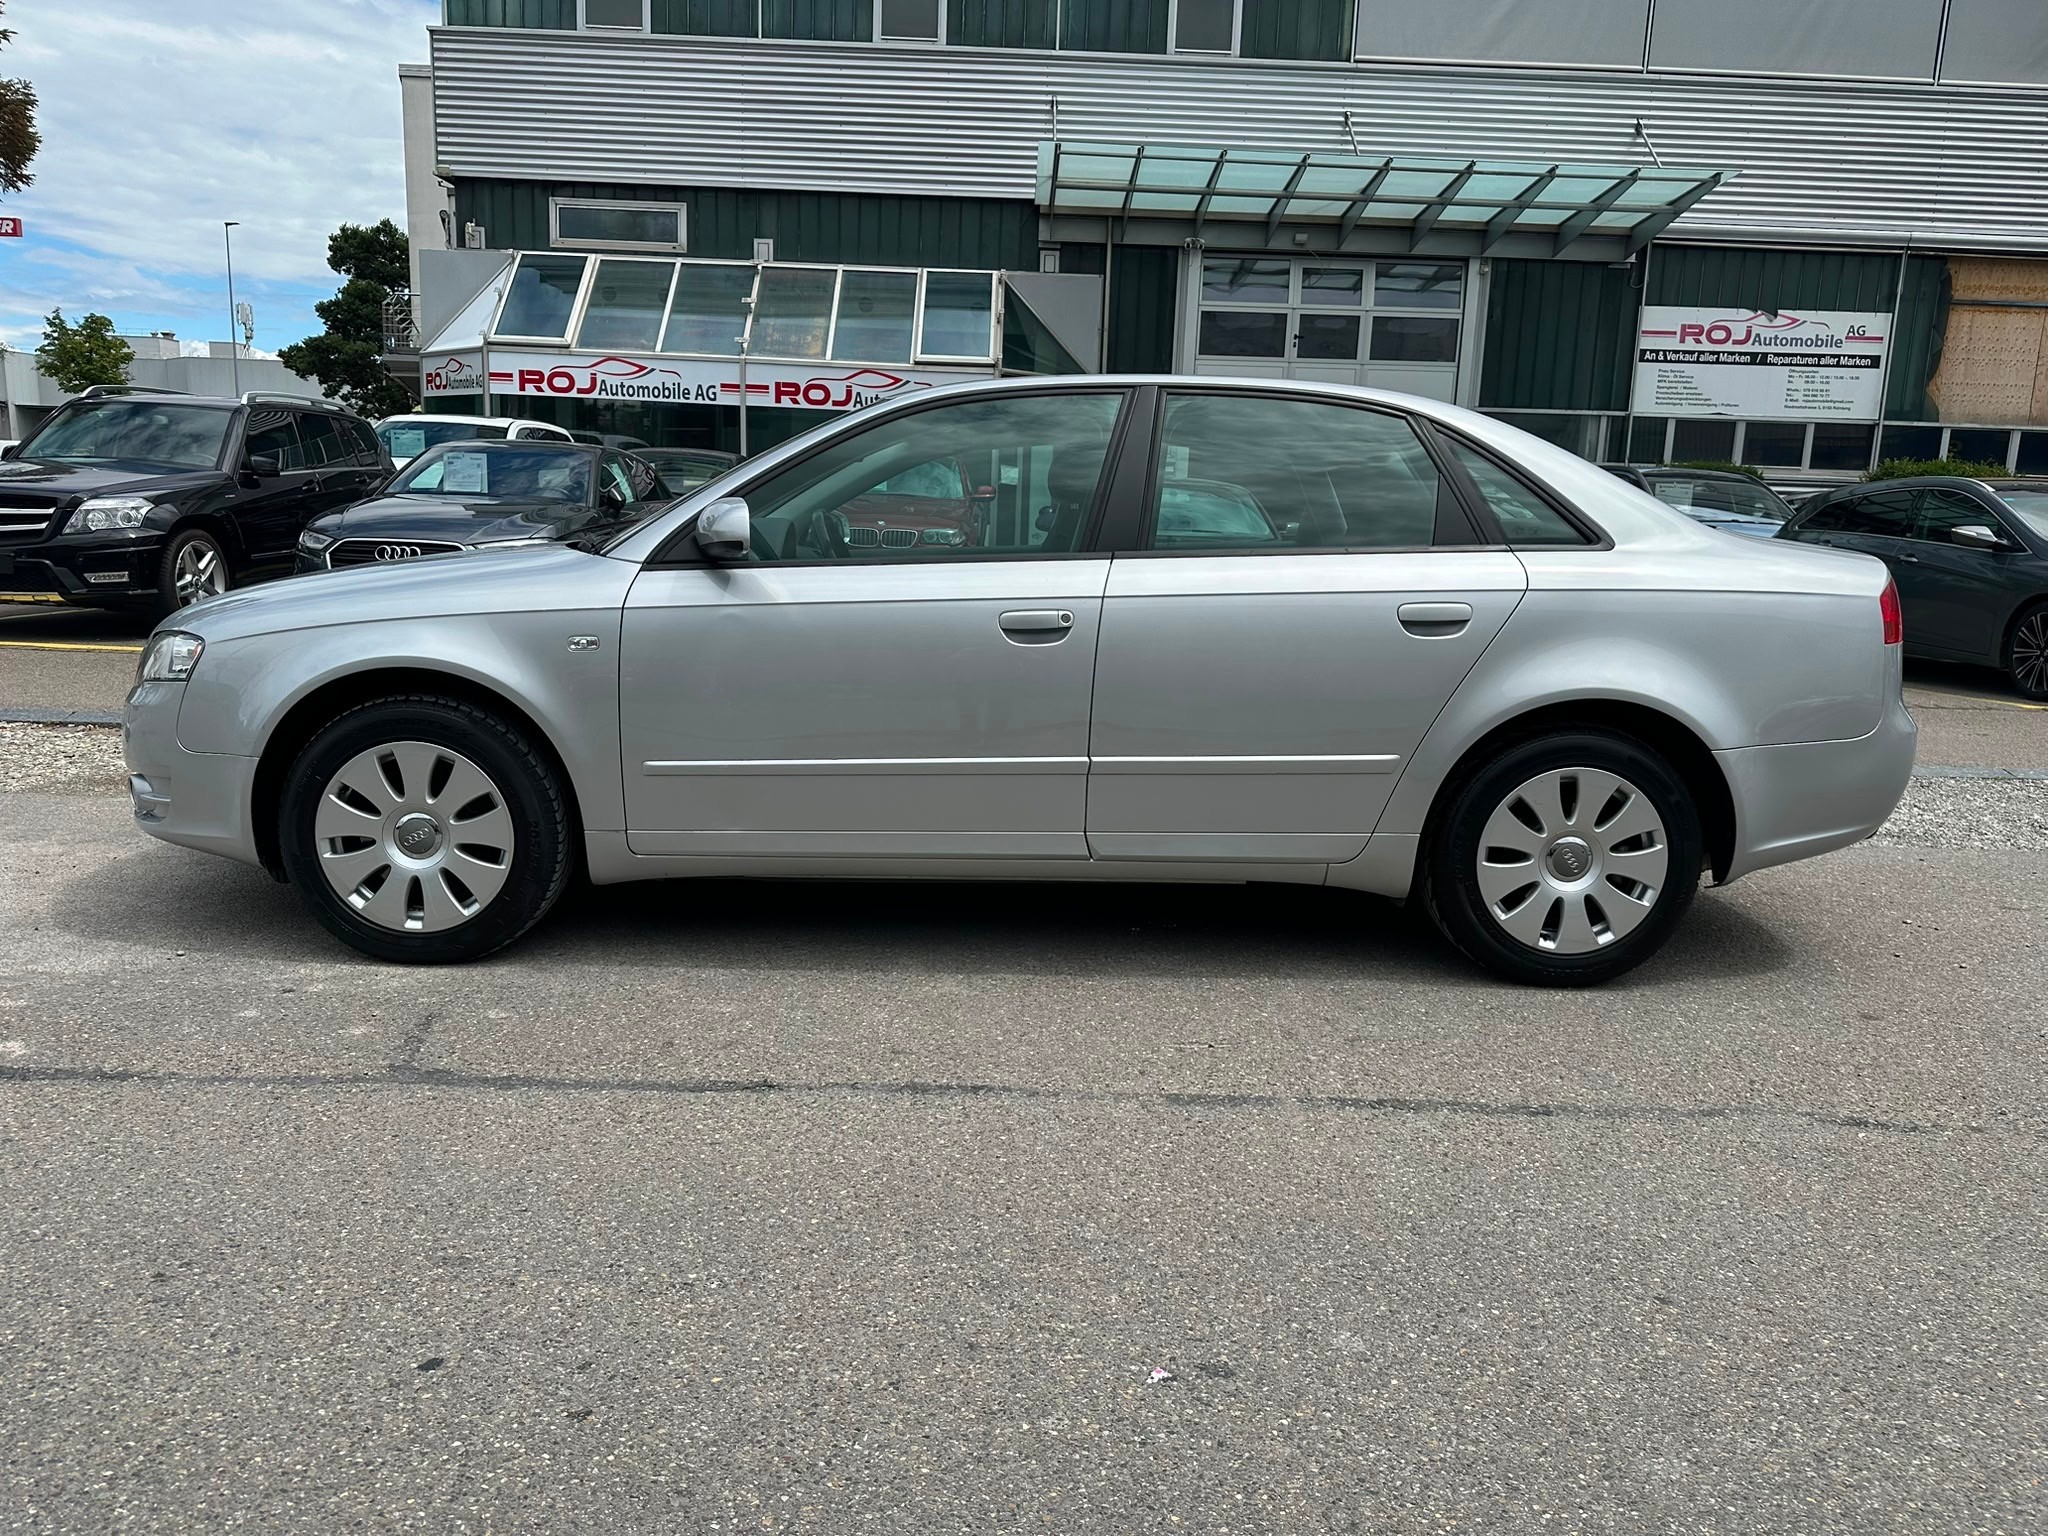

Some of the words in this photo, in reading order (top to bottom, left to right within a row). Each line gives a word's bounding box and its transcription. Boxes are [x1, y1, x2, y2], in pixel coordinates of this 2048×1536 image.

[0, 219, 14, 233] R
[1679, 323, 1752, 346] ROJ
[1751, 333, 1844, 349] Automobile
[1847, 325, 1866, 337] AG
[1644, 351, 1656, 360] An
[1658, 351, 1664, 360] &
[1666, 351, 1698, 361] Verkauf
[1699, 352, 1718, 362] aller
[1719, 353, 1751, 363] Marken
[1767, 354, 1818, 365] Reparaturen
[1820, 356, 1838, 365] aller
[1840, 356, 1871, 366] Marken
[426, 372, 448, 390] ROJ
[449, 376, 474, 389] Automobile
[475, 374, 483, 389] AG
[518, 369, 597, 394] ROJ
[598, 380, 691, 401] Automobile
[695, 384, 717, 401] AG
[775, 382, 852, 407] ROJ
[853, 392, 881, 408] Aut
